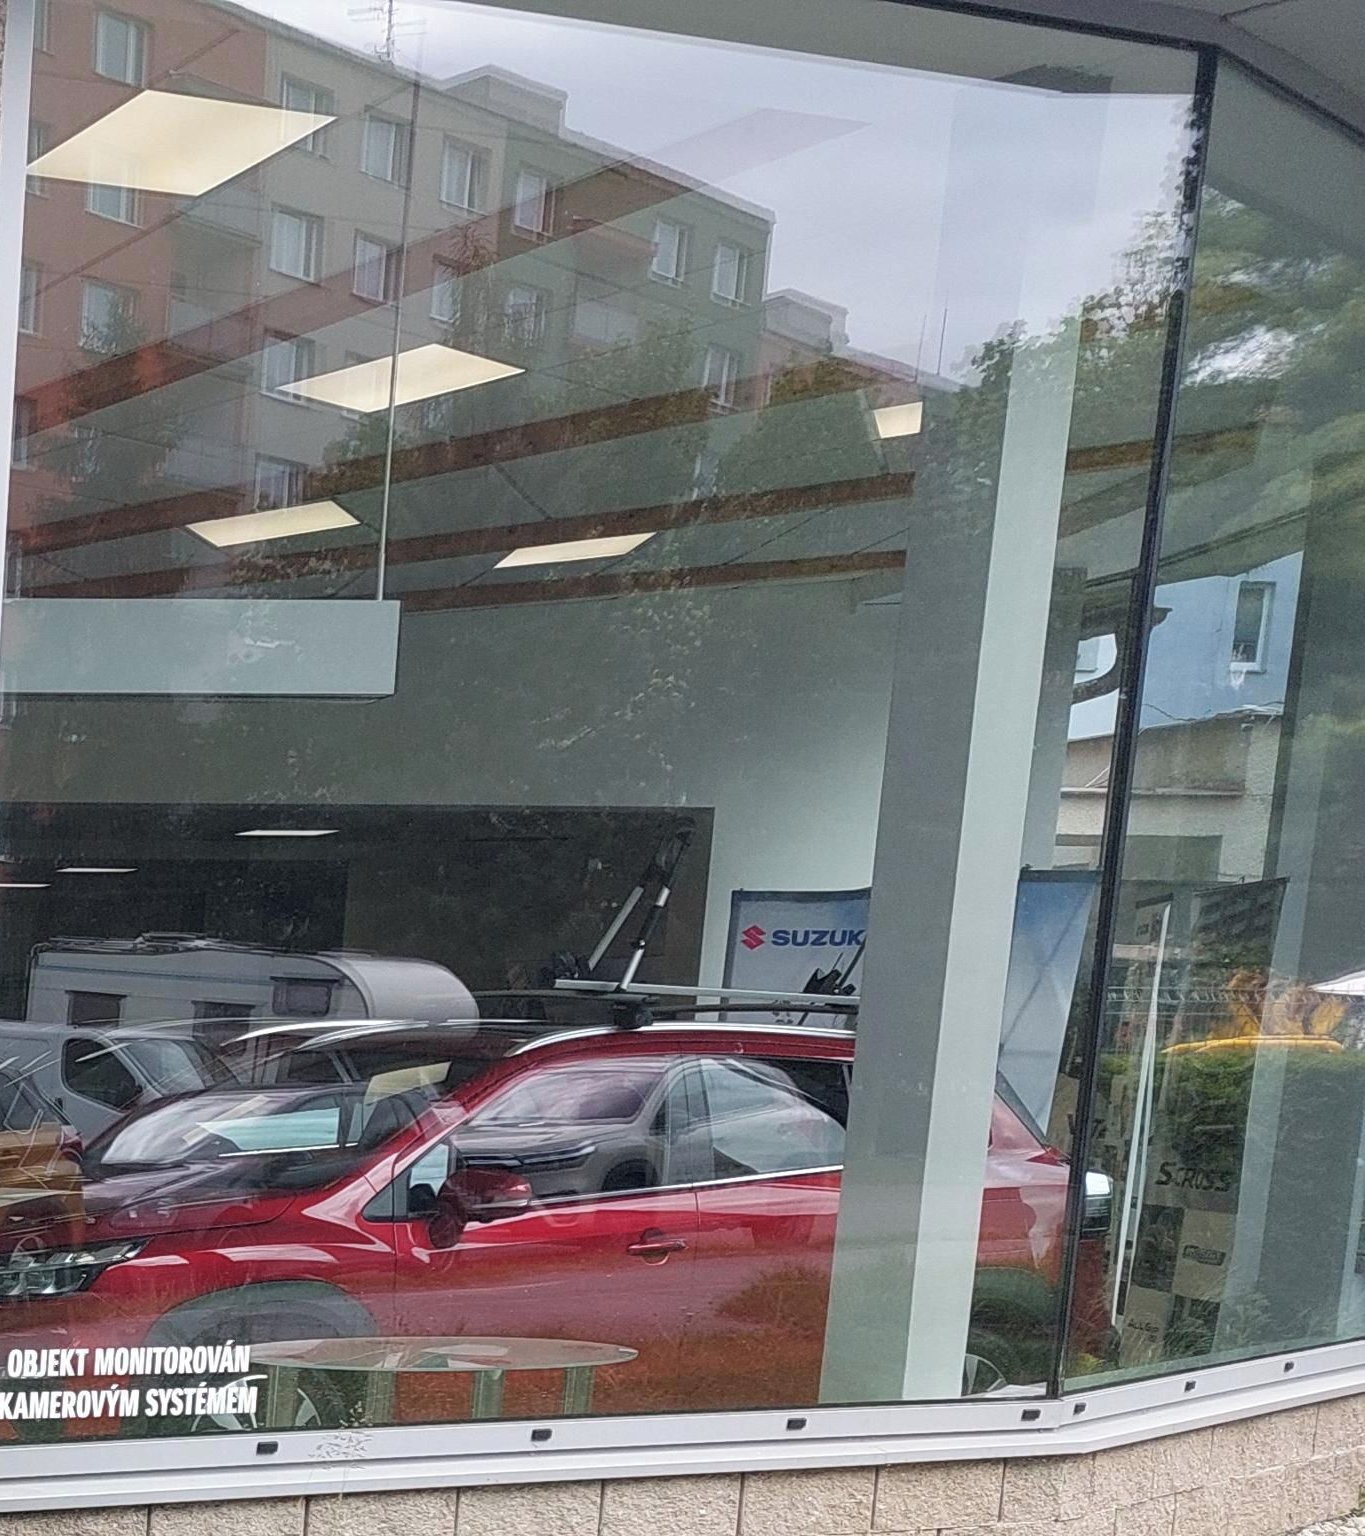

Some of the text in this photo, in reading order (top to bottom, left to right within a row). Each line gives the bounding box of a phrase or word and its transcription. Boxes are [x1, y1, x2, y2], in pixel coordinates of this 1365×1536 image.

[7, 1339, 251, 1378] OBJEKT MONITOROVÁN
[144, 1382, 259, 1417] SYSTÉMEM
